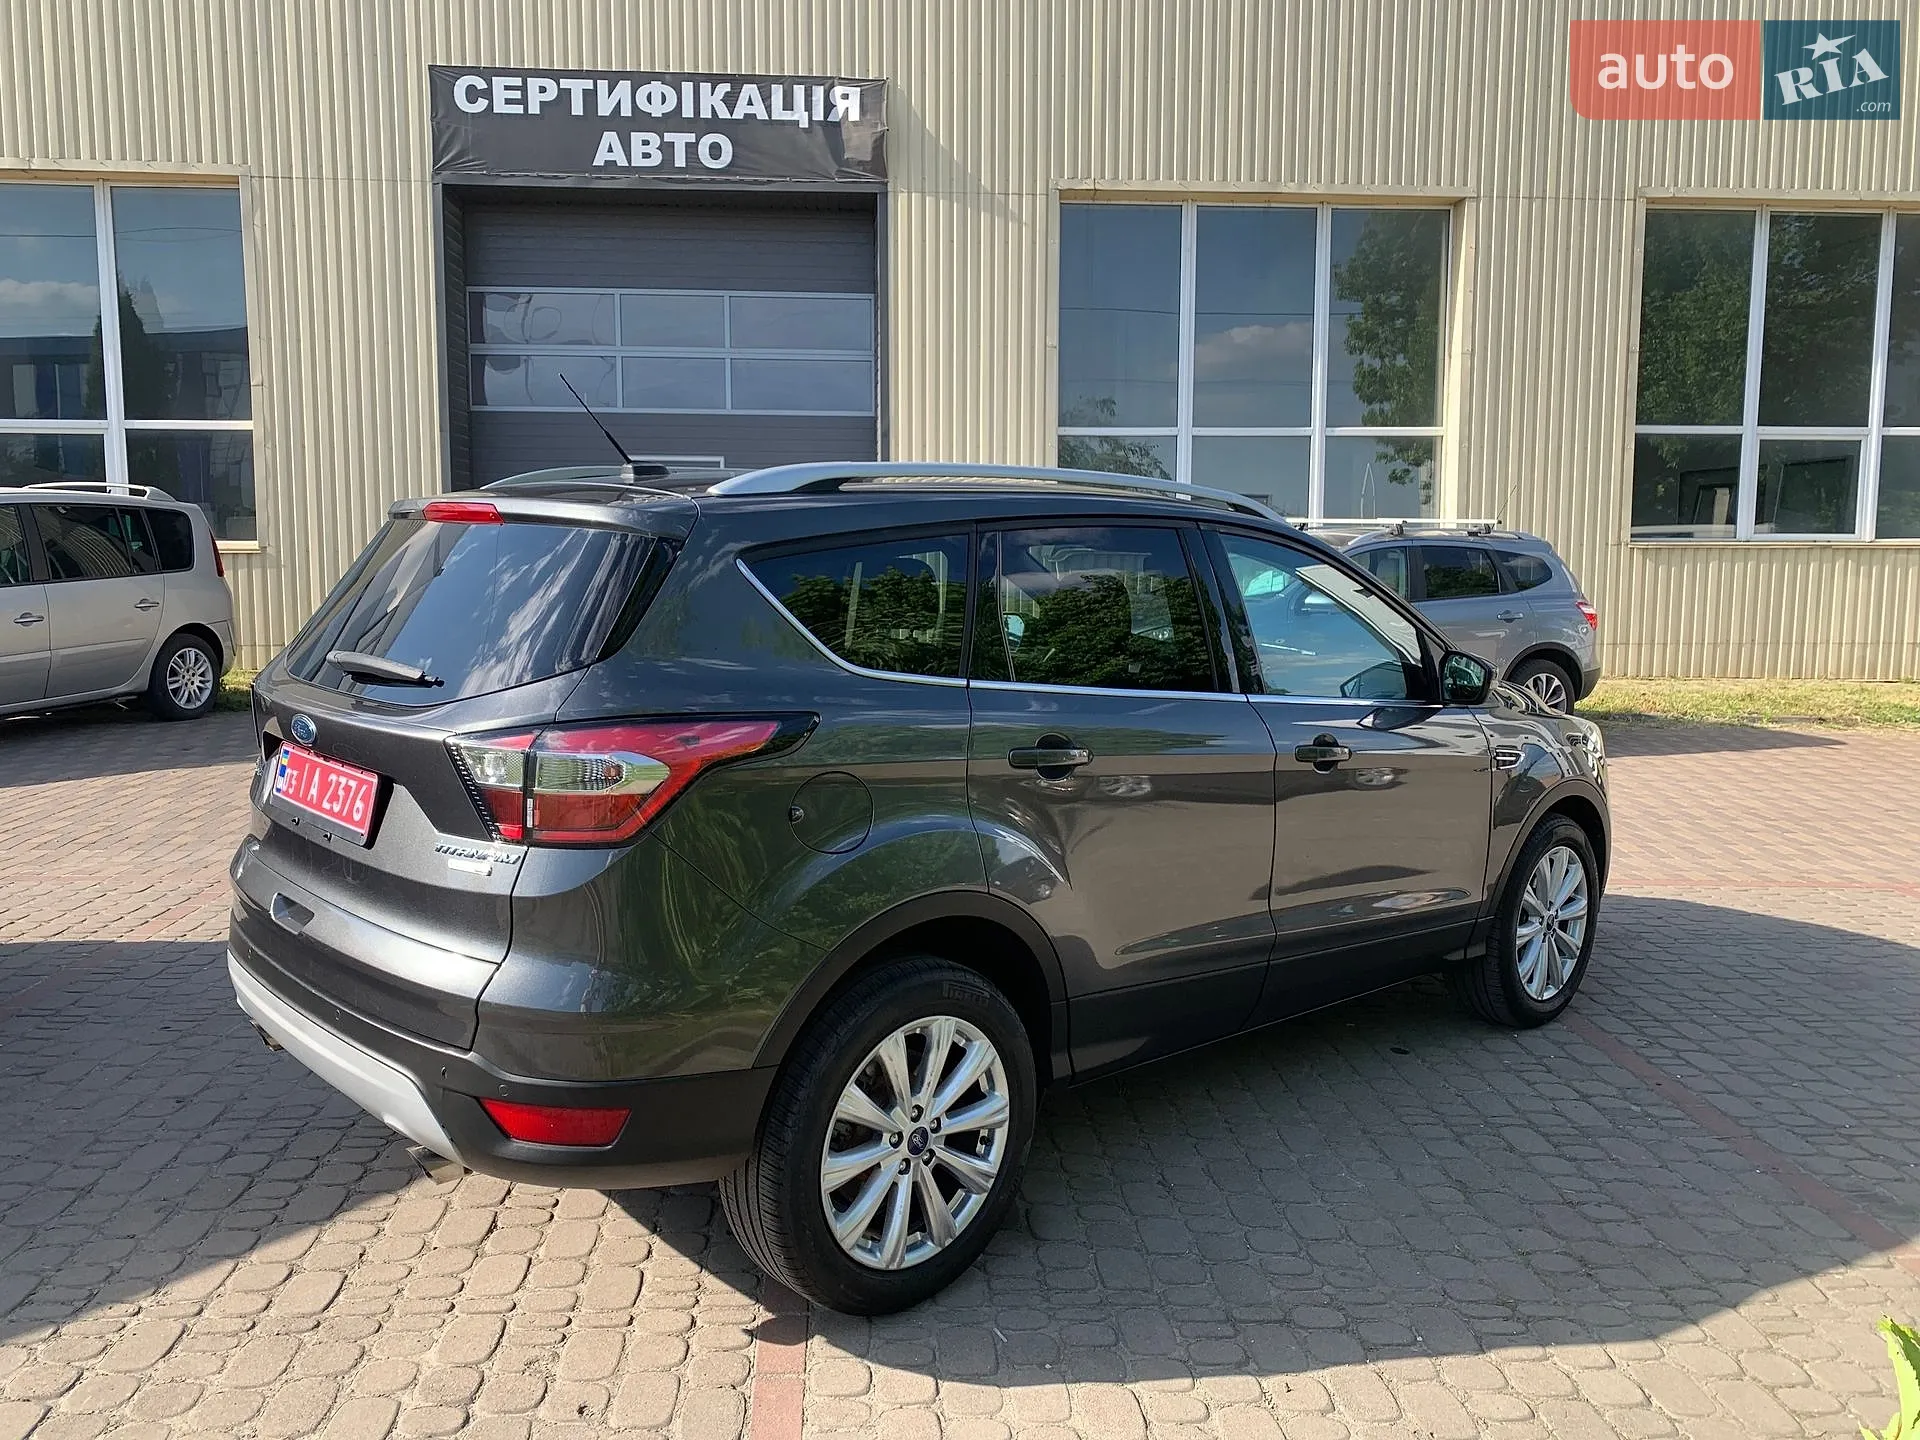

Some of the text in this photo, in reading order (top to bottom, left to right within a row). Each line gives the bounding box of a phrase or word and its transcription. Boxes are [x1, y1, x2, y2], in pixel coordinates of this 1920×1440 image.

[452, 74, 861, 129] СЕРТИФІКАЦІЯ
[592, 131, 734, 170] АВТО
[321, 772, 368, 822] 2376
[434, 842, 521, 865] TITANM
